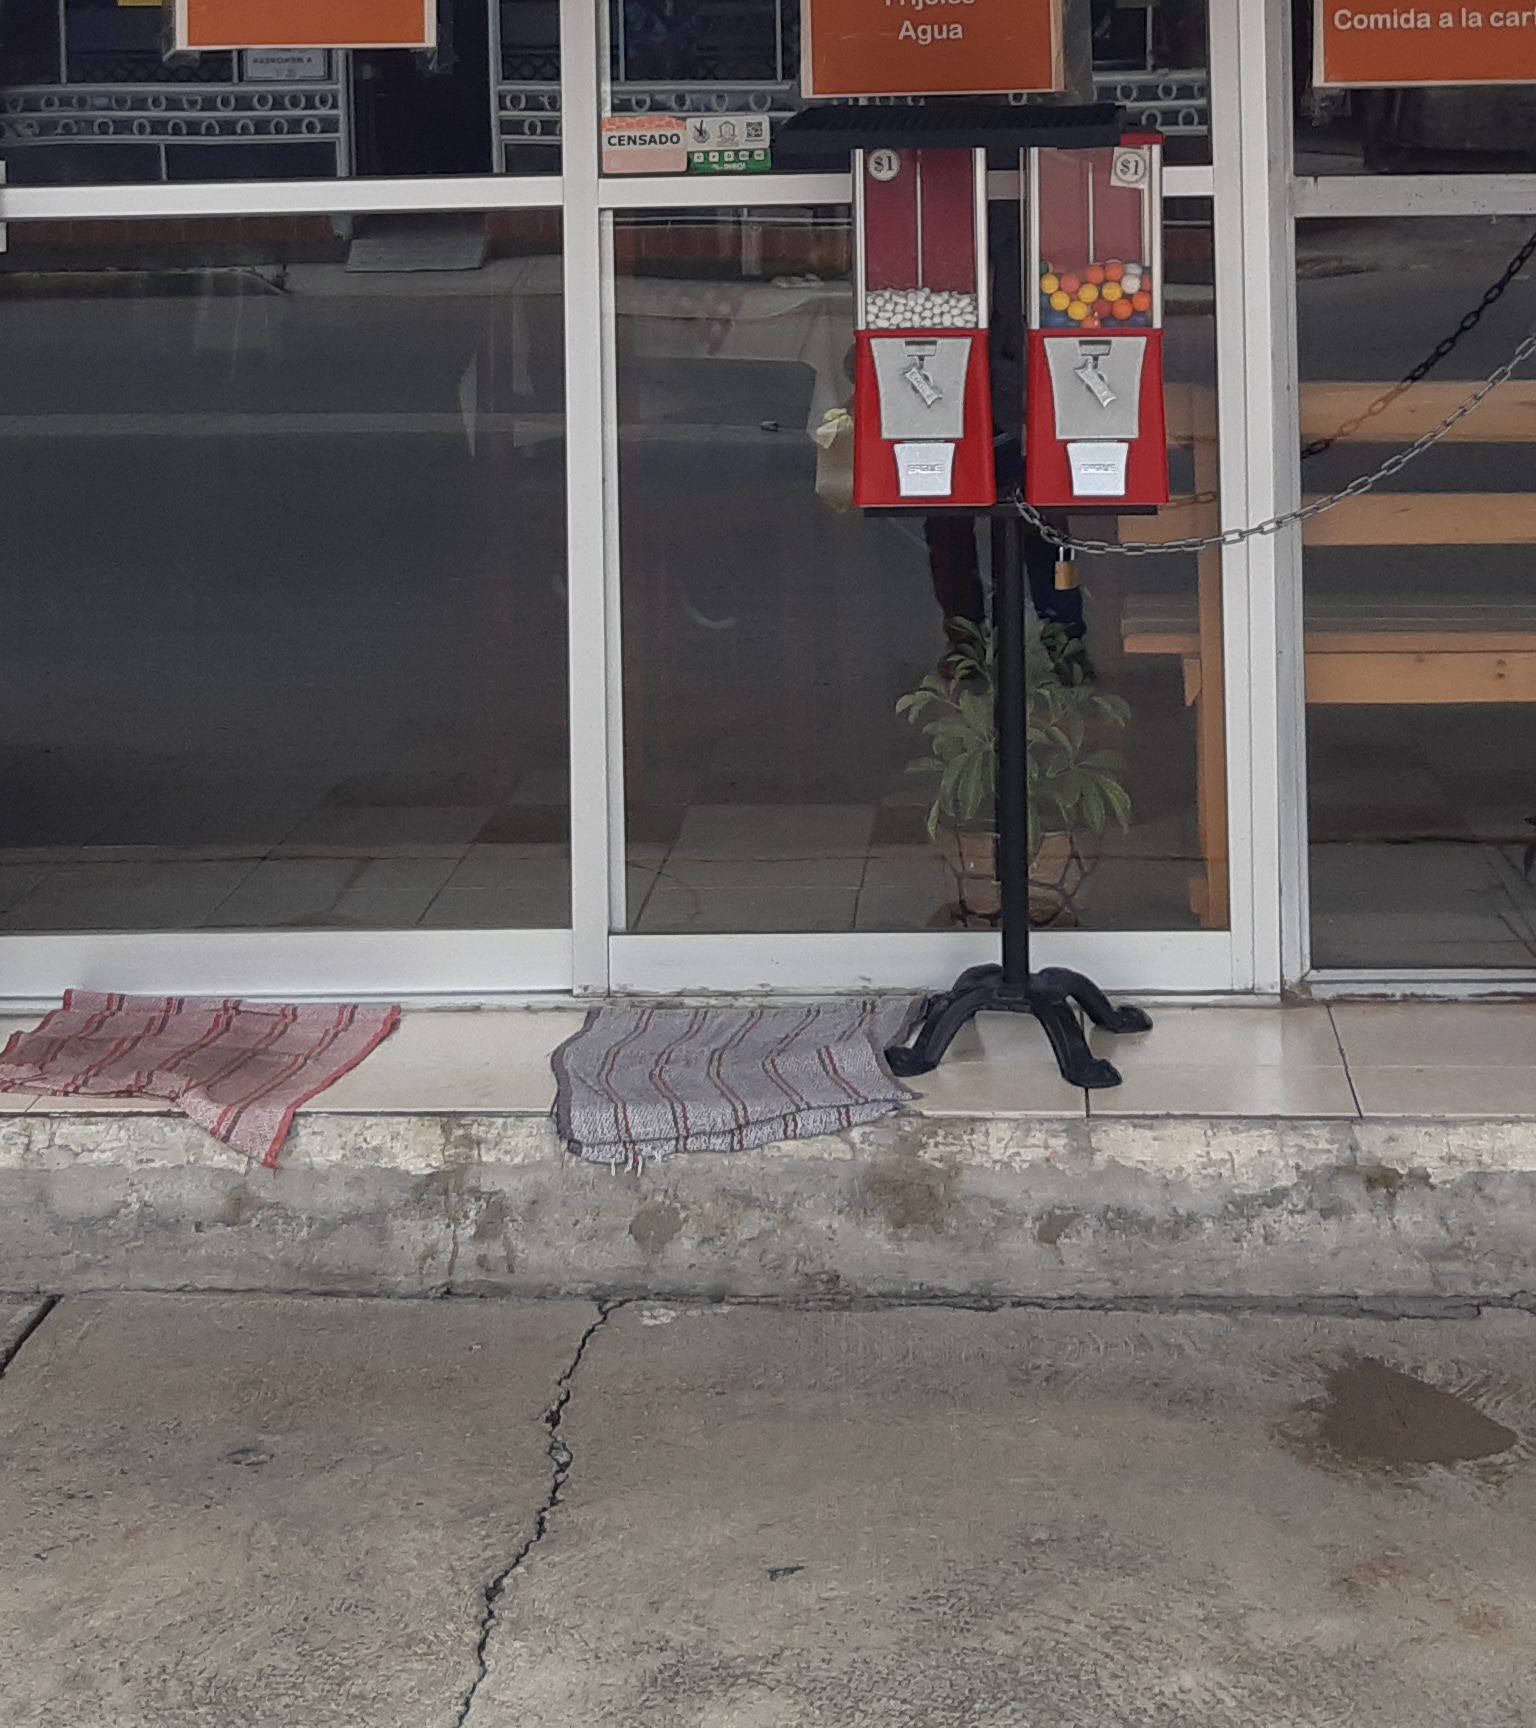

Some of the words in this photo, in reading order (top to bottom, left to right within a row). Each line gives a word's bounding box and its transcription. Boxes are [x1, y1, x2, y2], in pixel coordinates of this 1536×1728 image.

[1333, 7, 1432, 31] Comida
[1438, 13, 1455, 29] a
[1461, 7, 1483, 29] la
[897, 20, 965, 46] Agua
[607, 133, 681, 147] CENSADO
[873, 153, 895, 173] $1
[1119, 157, 1141, 177] $1
